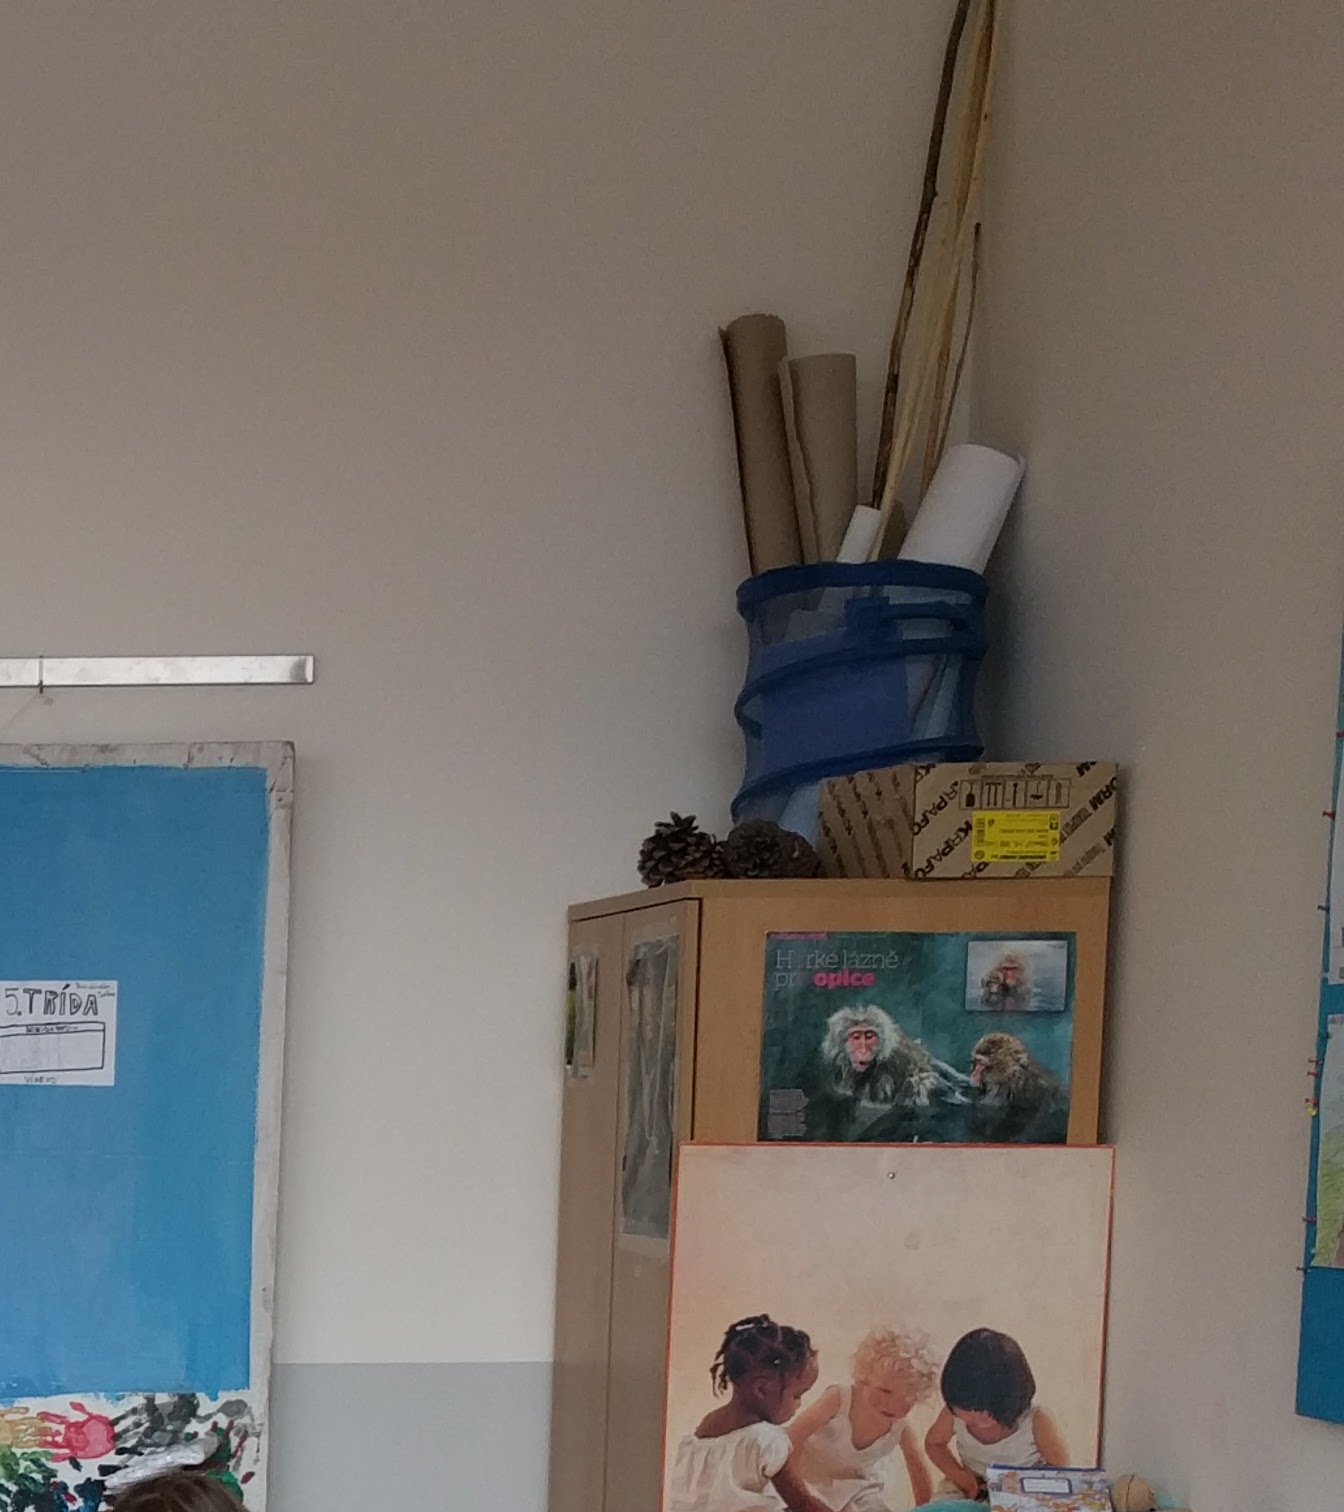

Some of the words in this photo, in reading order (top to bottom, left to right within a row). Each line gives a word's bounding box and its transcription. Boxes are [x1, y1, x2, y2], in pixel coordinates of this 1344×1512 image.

[776, 949, 839, 969] Hrké
[843, 949, 900, 969] lázně
[814, 968, 875, 990] opice
